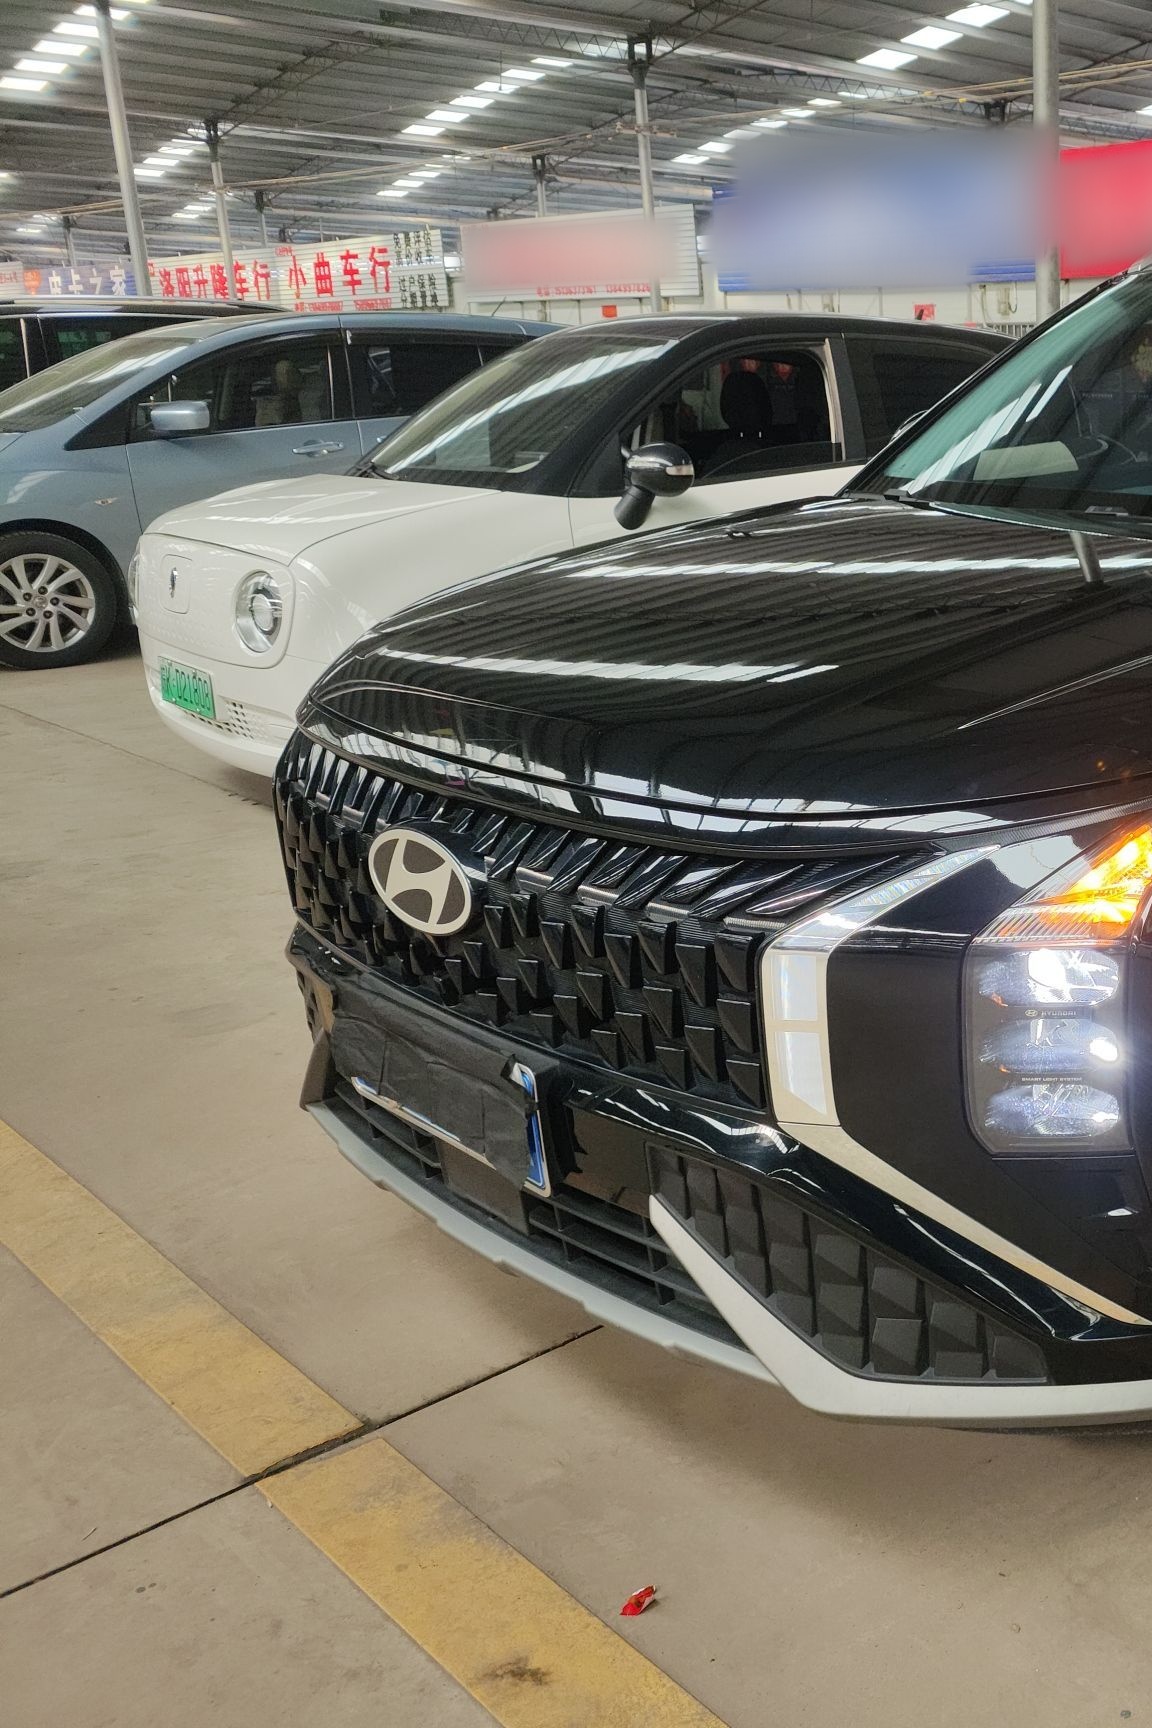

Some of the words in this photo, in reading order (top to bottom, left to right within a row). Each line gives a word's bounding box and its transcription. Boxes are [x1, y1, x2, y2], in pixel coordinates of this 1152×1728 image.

[159, 260, 271, 300] 洛阳升隆车行
[288, 246, 391, 299] 小曲车行
